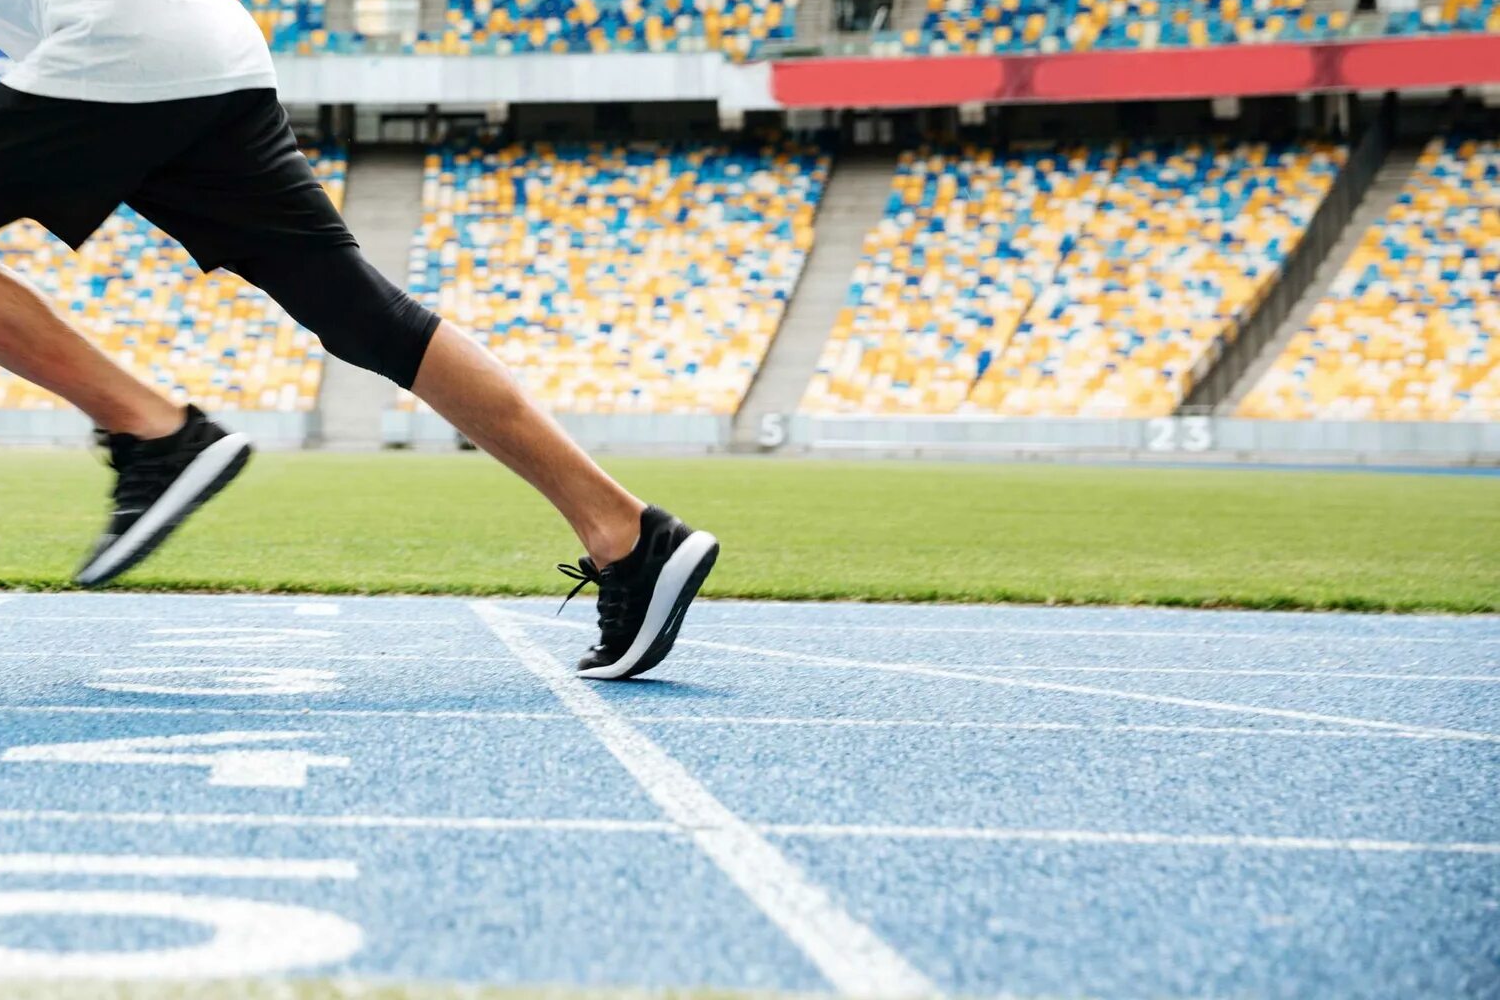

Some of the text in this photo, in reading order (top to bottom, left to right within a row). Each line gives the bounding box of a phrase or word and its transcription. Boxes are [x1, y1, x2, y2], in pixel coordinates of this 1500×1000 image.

[1148, 416, 1212, 451] 23
[84, 666, 346, 696] 3
[0, 731, 351, 788] 4
